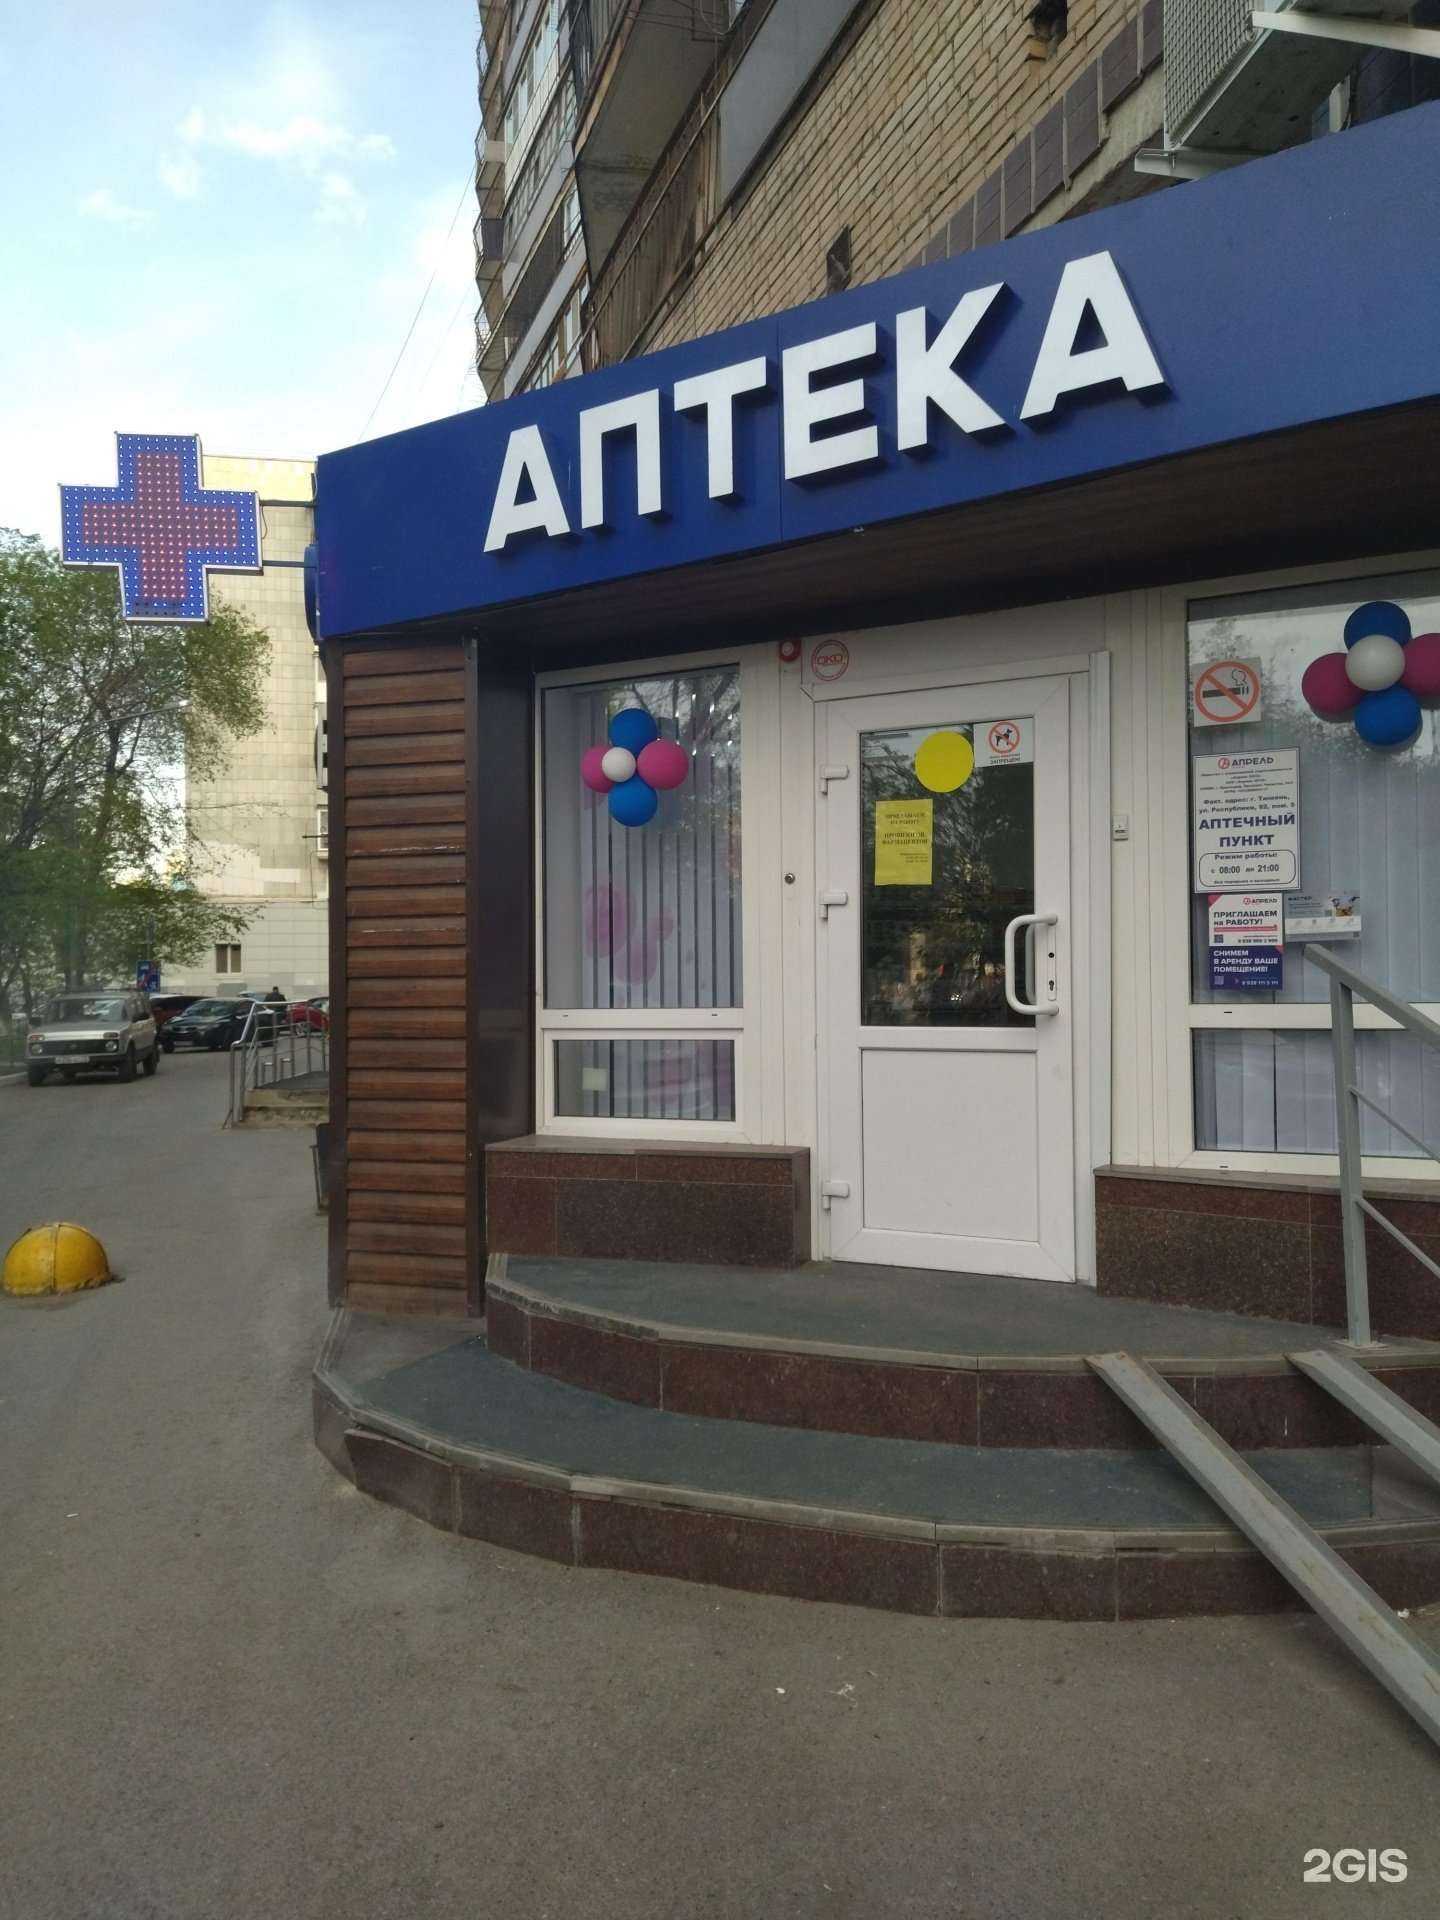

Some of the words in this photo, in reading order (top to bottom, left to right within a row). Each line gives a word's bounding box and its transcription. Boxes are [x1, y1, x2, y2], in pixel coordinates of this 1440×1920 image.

[483, 250, 1165, 553] АПТЕКА
[1231, 757, 1274, 767] АПРЕЛЬ
[1199, 812, 1295, 830] АПТЕЧНЫЙ
[1219, 834, 1275, 848] ПУНКТ
[1219, 866, 1241, 874] 08:00
[1257, 864, 1280, 873] 21:00
[1213, 910, 1278, 918] ПРИГЛАШАЕМ
[1225, 918, 1263, 926] РАБОТУ!
